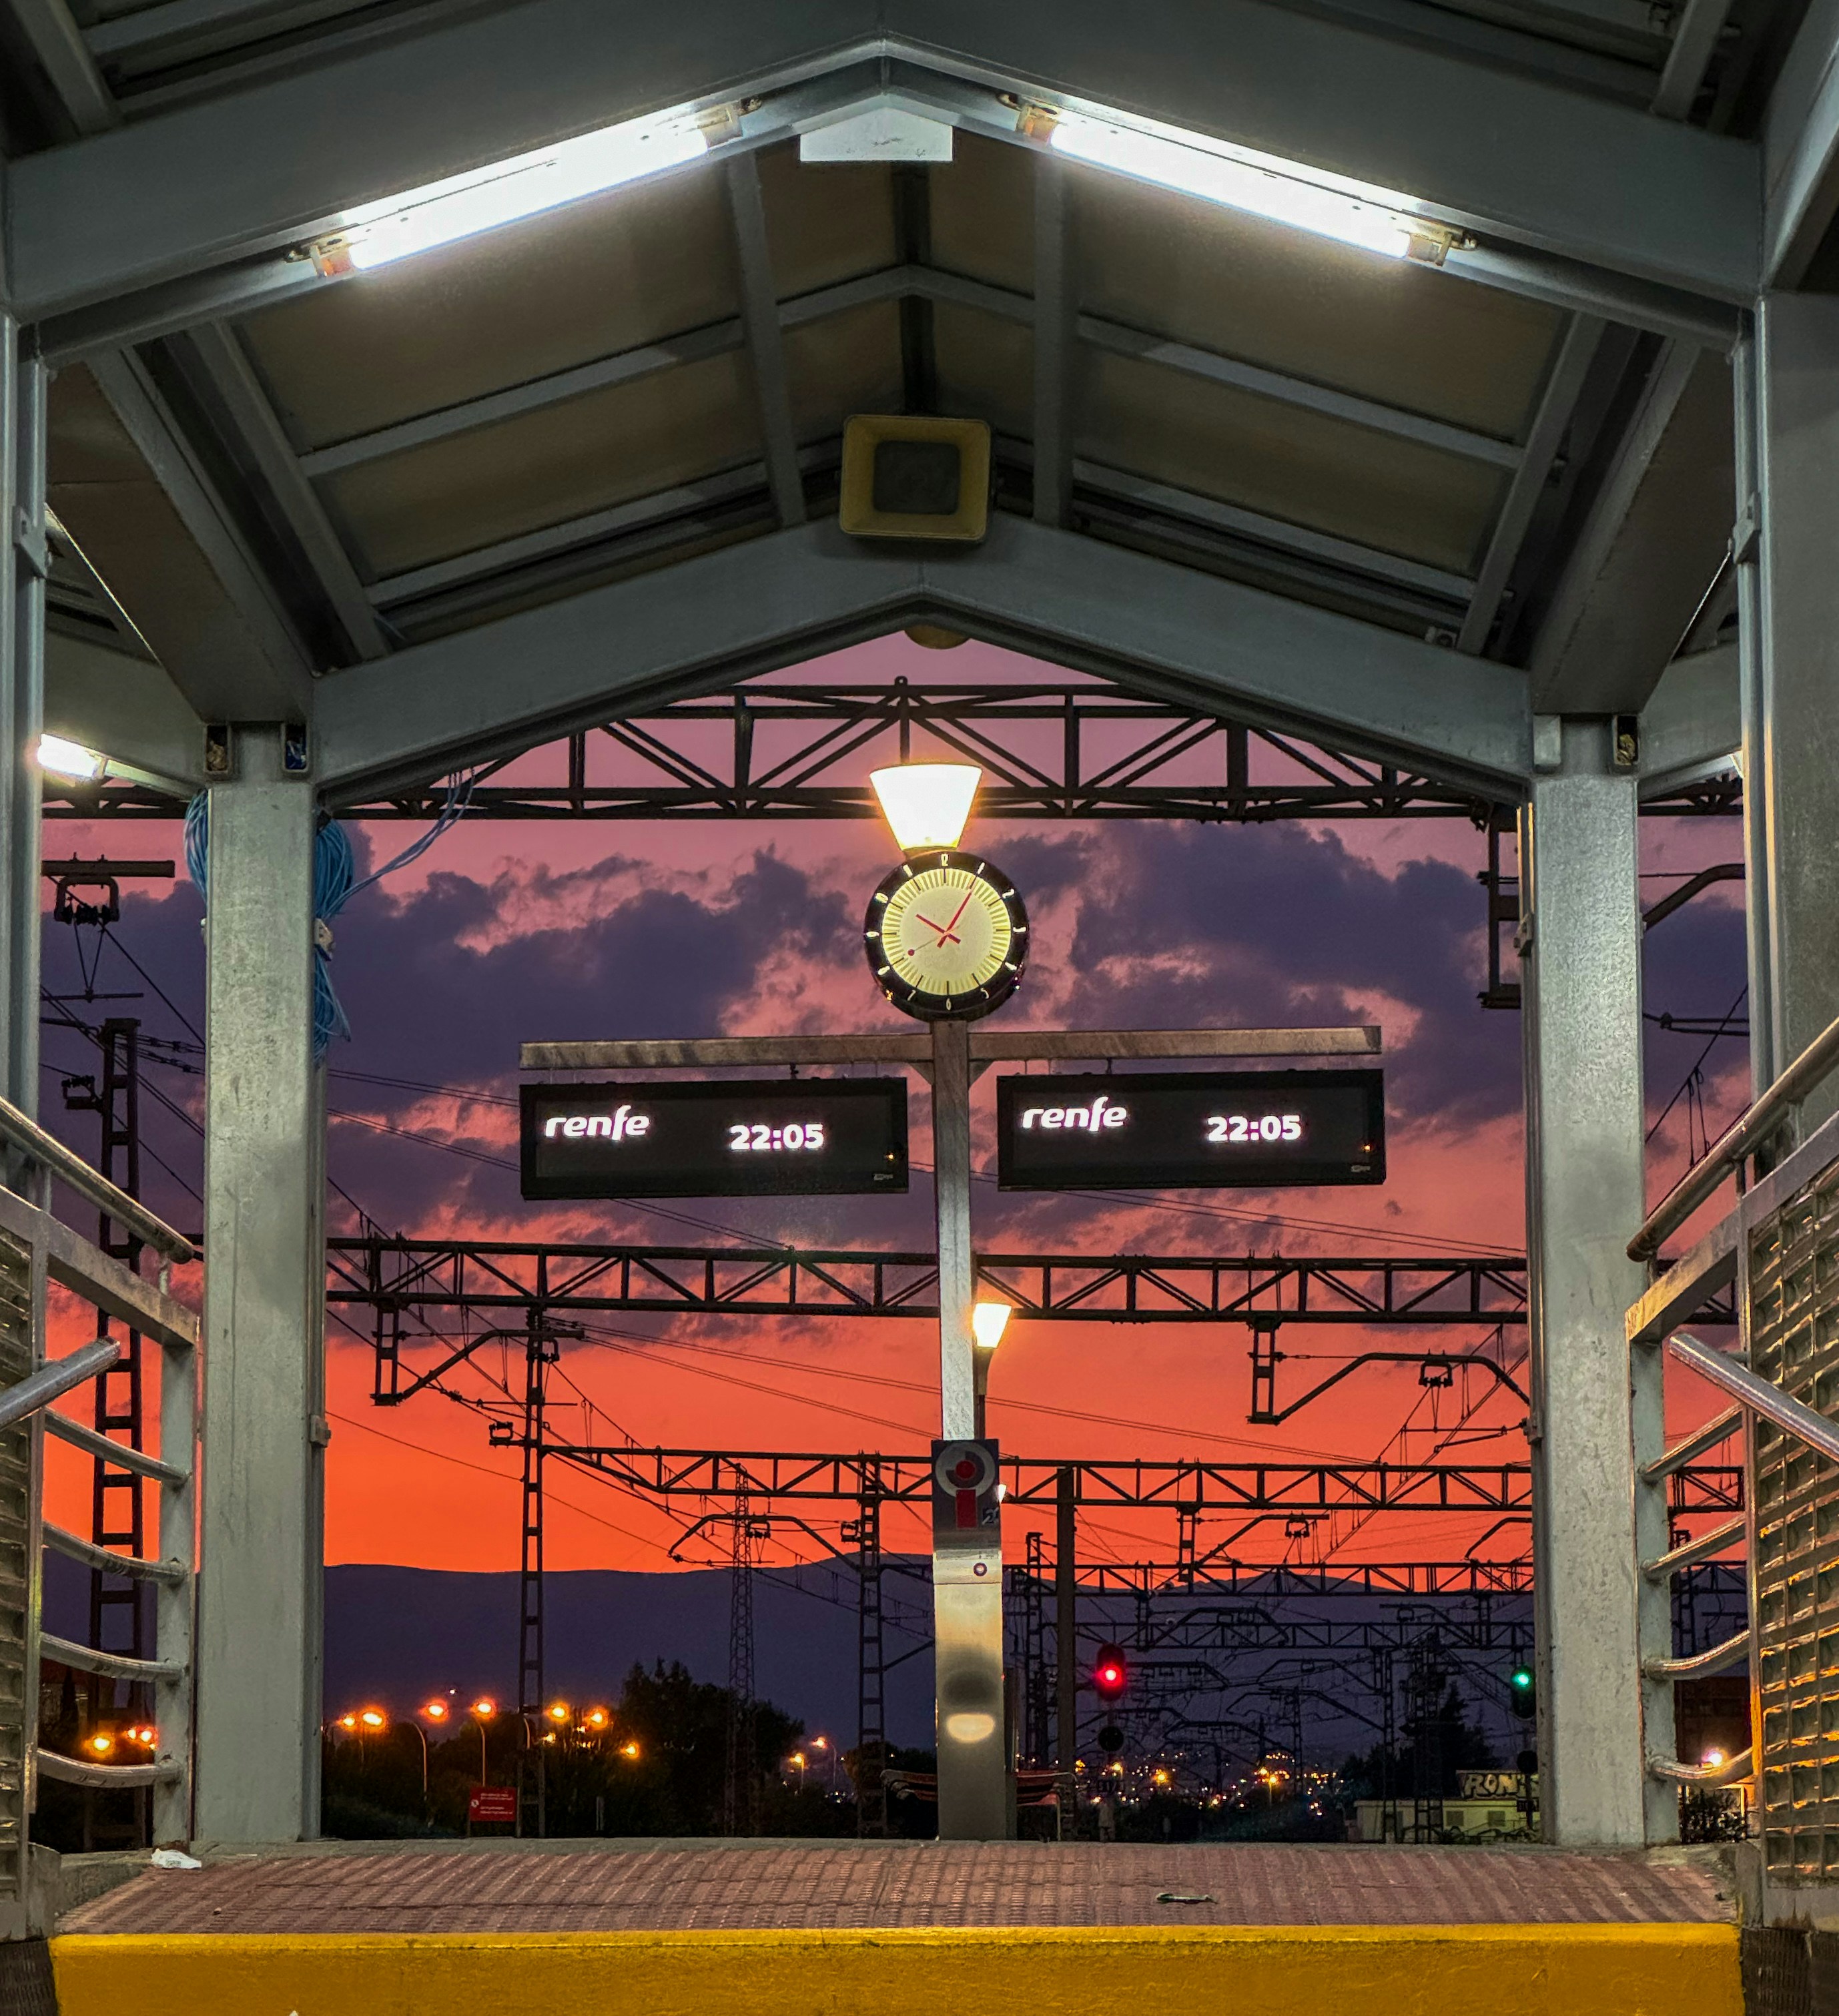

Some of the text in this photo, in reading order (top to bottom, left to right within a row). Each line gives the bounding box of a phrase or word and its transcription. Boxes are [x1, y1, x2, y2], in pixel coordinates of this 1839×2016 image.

[545, 1104, 650, 1141] renfe
[1022, 1096, 1127, 1132] renfe
[1208, 1115, 1302, 1142] 22:05
[731, 1124, 824, 1151] 22:05
